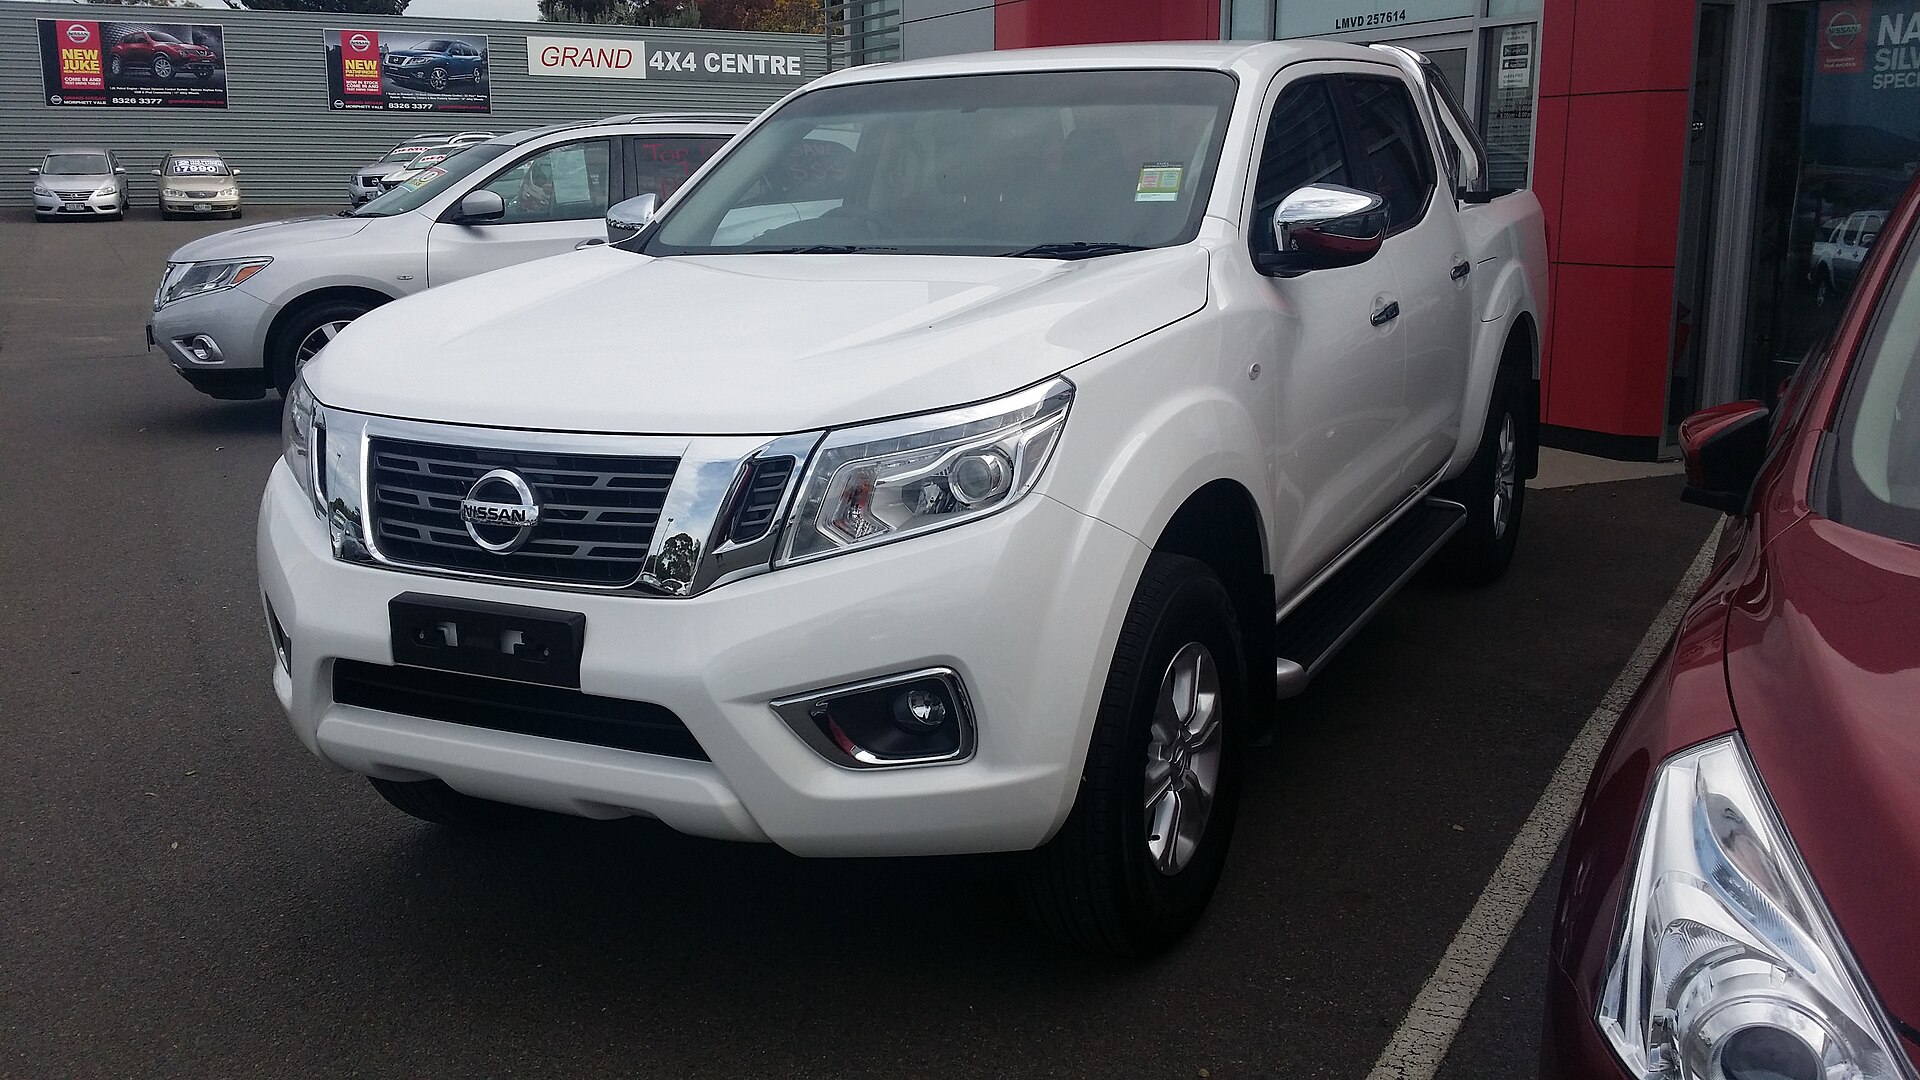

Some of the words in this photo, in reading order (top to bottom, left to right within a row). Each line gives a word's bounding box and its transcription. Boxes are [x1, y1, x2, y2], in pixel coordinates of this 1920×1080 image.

[1335, 16, 1365, 30] LMVD
[1366, 9, 1406, 26] 257614
[1828, 25, 1859, 35] NISSAN
[62, 49, 98, 60] NEW
[63, 60, 100, 71] JUKE
[345, 60, 377, 70] NEW
[540, 46, 633, 69] GRAND
[649, 50, 697, 72] 4X4
[703, 53, 801, 76] CENTRE
[463, 504, 526, 523] NISSAN
